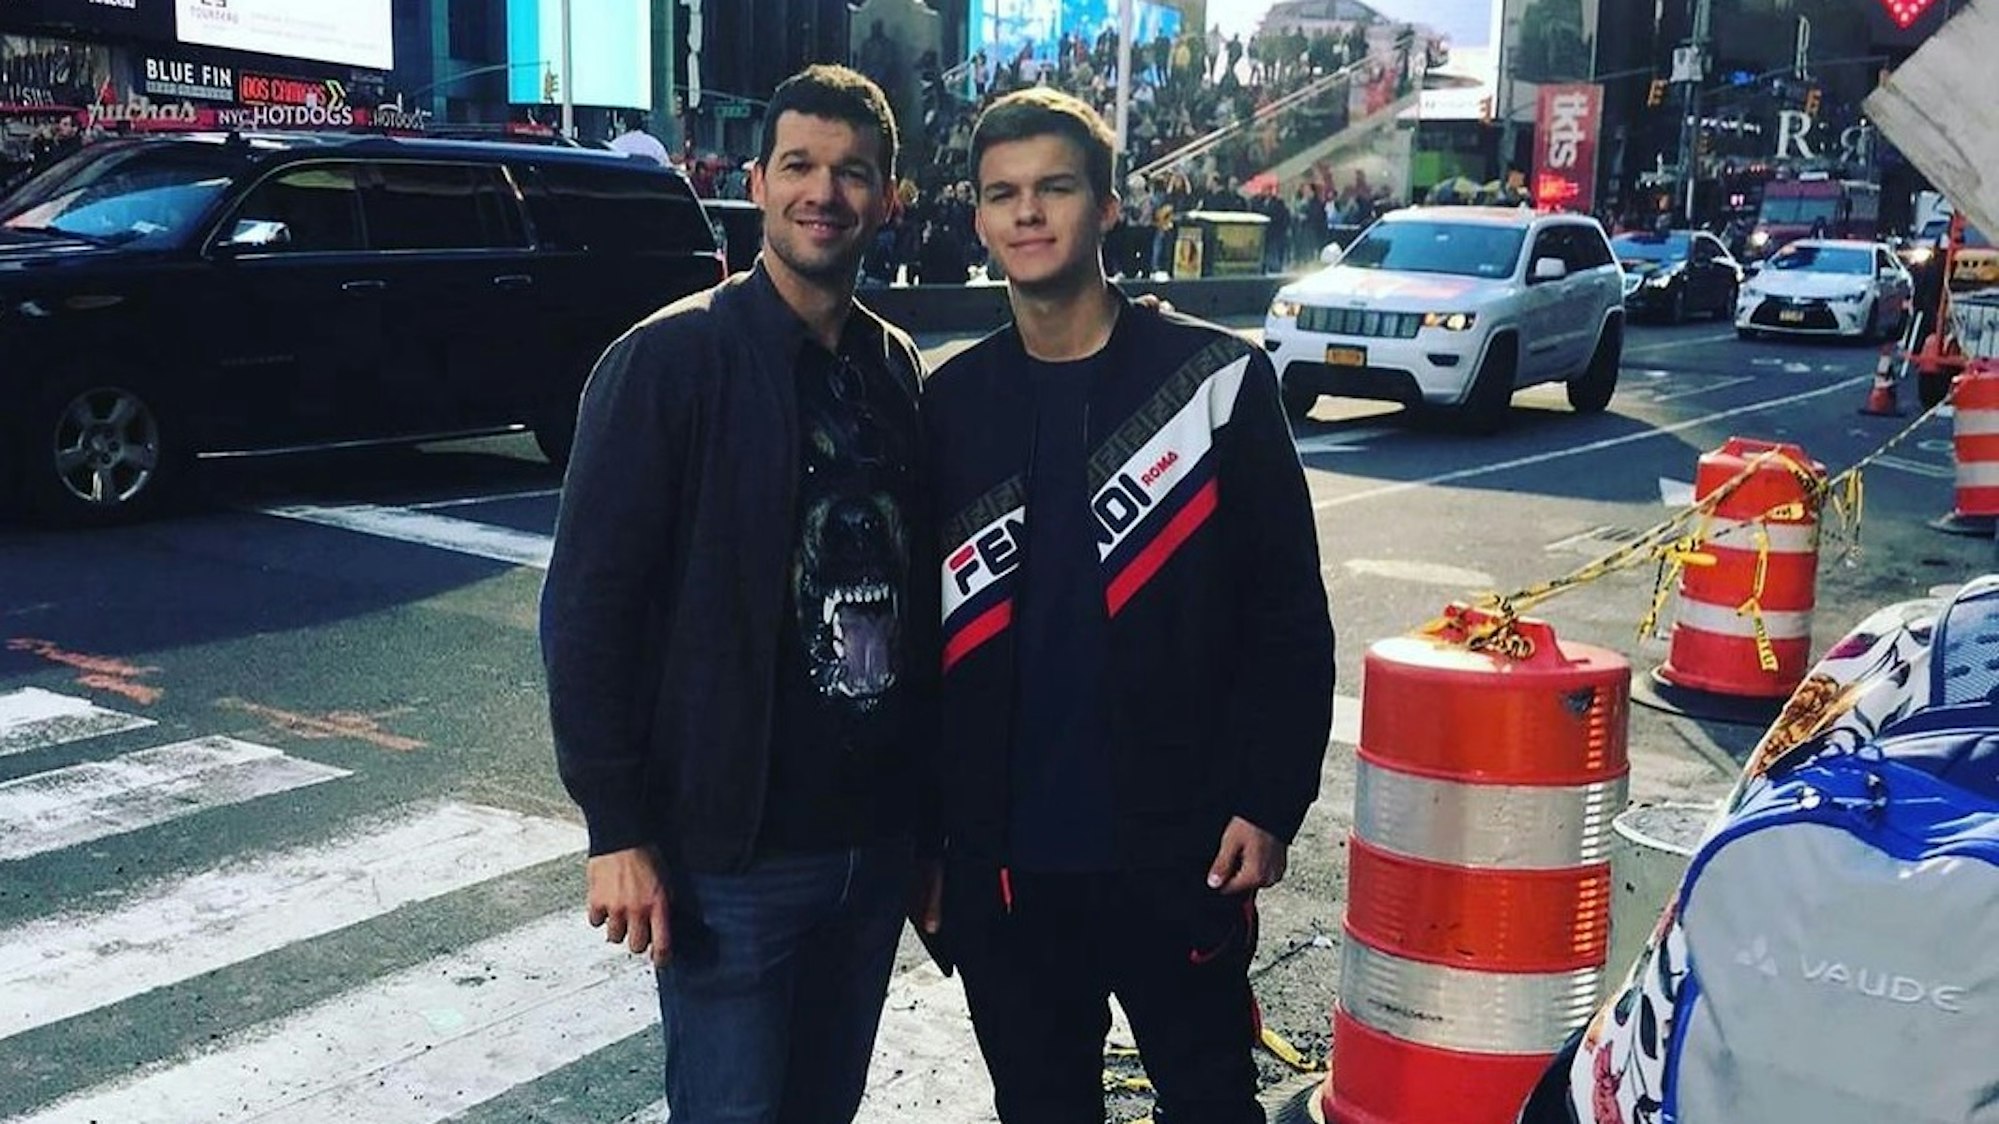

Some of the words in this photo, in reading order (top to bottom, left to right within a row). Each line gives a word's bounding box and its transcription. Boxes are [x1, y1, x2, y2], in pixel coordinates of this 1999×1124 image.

[146, 58, 194, 84] BLUE
[202, 65, 232, 87] FIN
[242, 75, 269, 100] DOS
[219, 109, 254, 125] NYC
[254, 105, 353, 125] HOTDOGS
[1549, 93, 1588, 168] tkts
[1774, 110, 1815, 159] R
[1141, 450, 1179, 487] ROMA
[1801, 954, 1968, 1013] VAUDE
